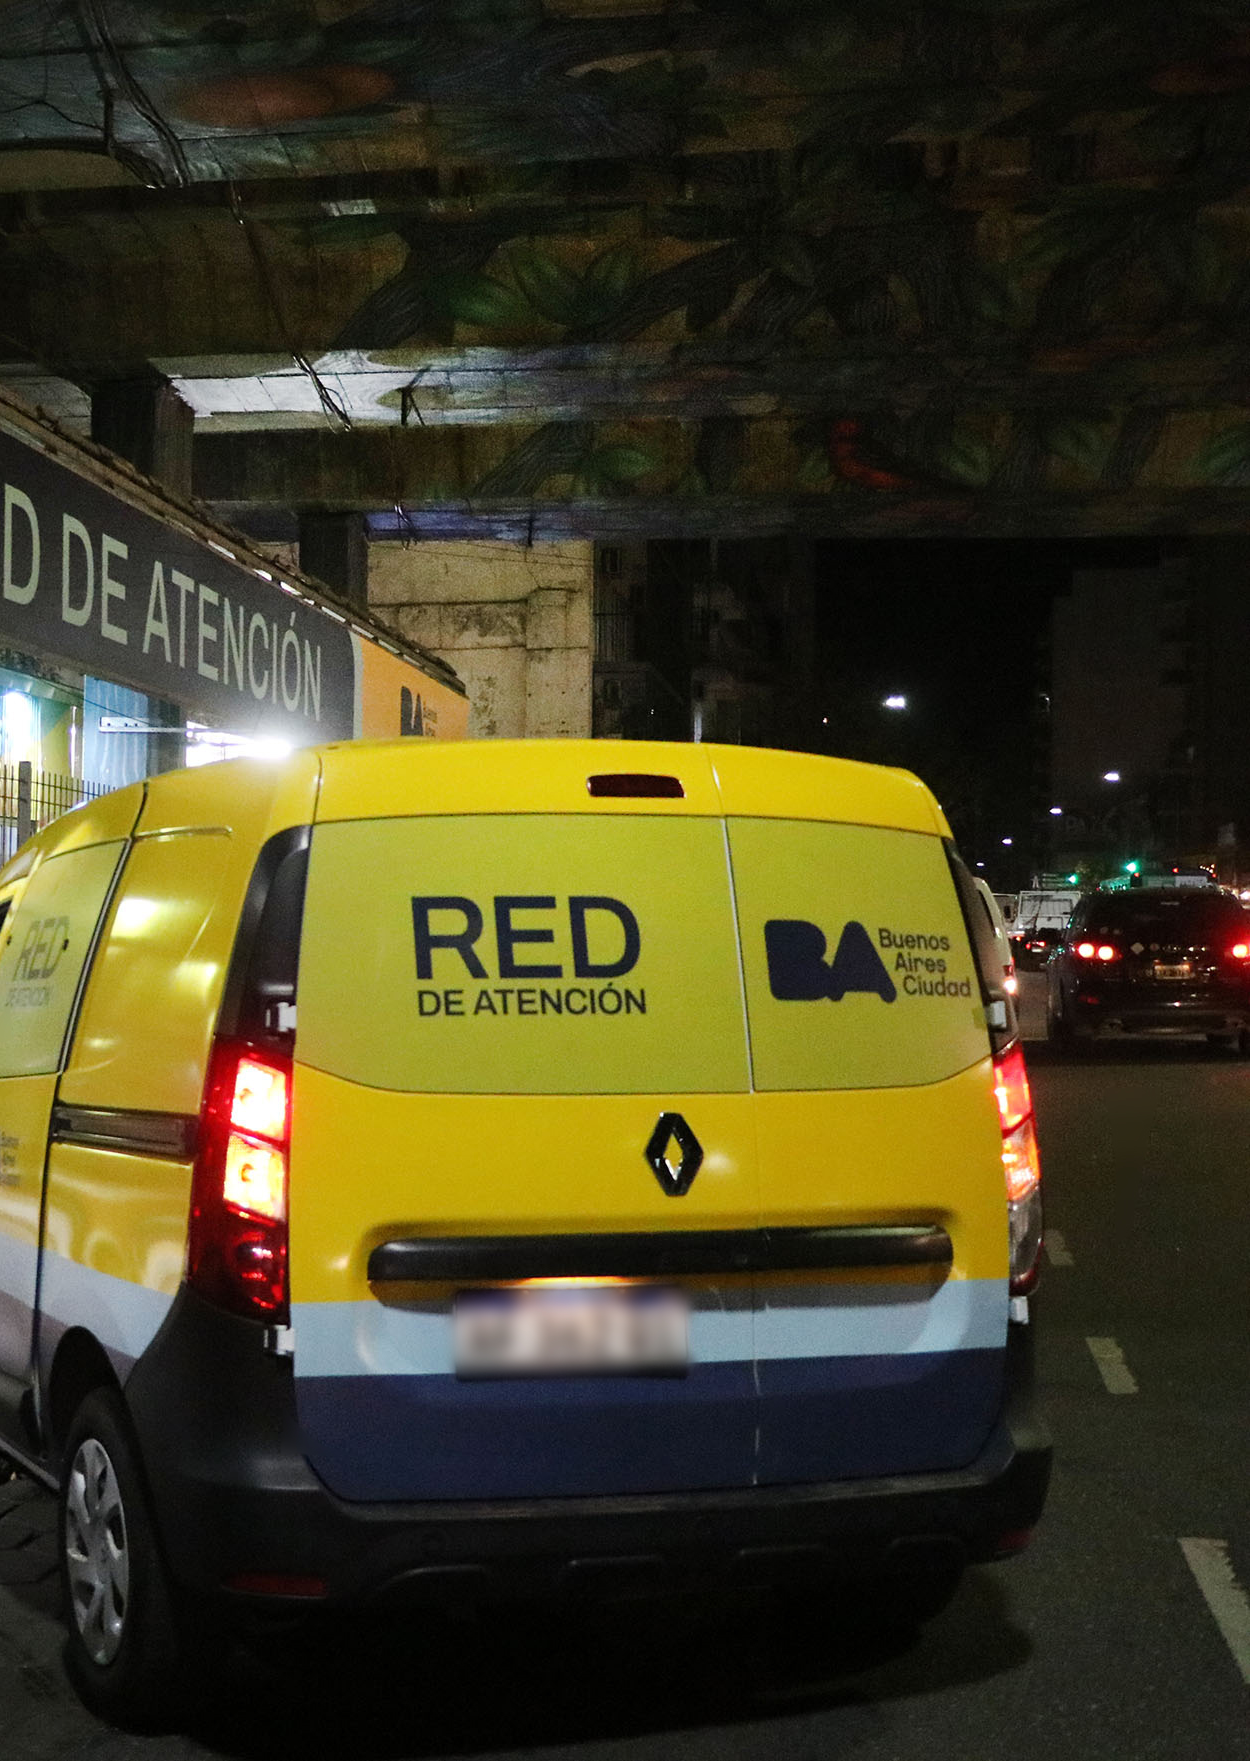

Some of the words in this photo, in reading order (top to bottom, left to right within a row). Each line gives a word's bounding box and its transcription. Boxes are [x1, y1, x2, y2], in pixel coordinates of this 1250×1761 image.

[61, 512, 129, 645] DE
[141, 559, 322, 721] ATENCIÓN
[12, 915, 70, 982] RED
[411, 896, 641, 979] RED
[764, 919, 897, 1003] BA
[878, 928, 950, 951] Buenos
[895, 952, 947, 973] Aires
[417, 989, 465, 1017] DE
[474, 982, 647, 1016] ATENCIÓN
[903, 975, 972, 998] Ciudad
